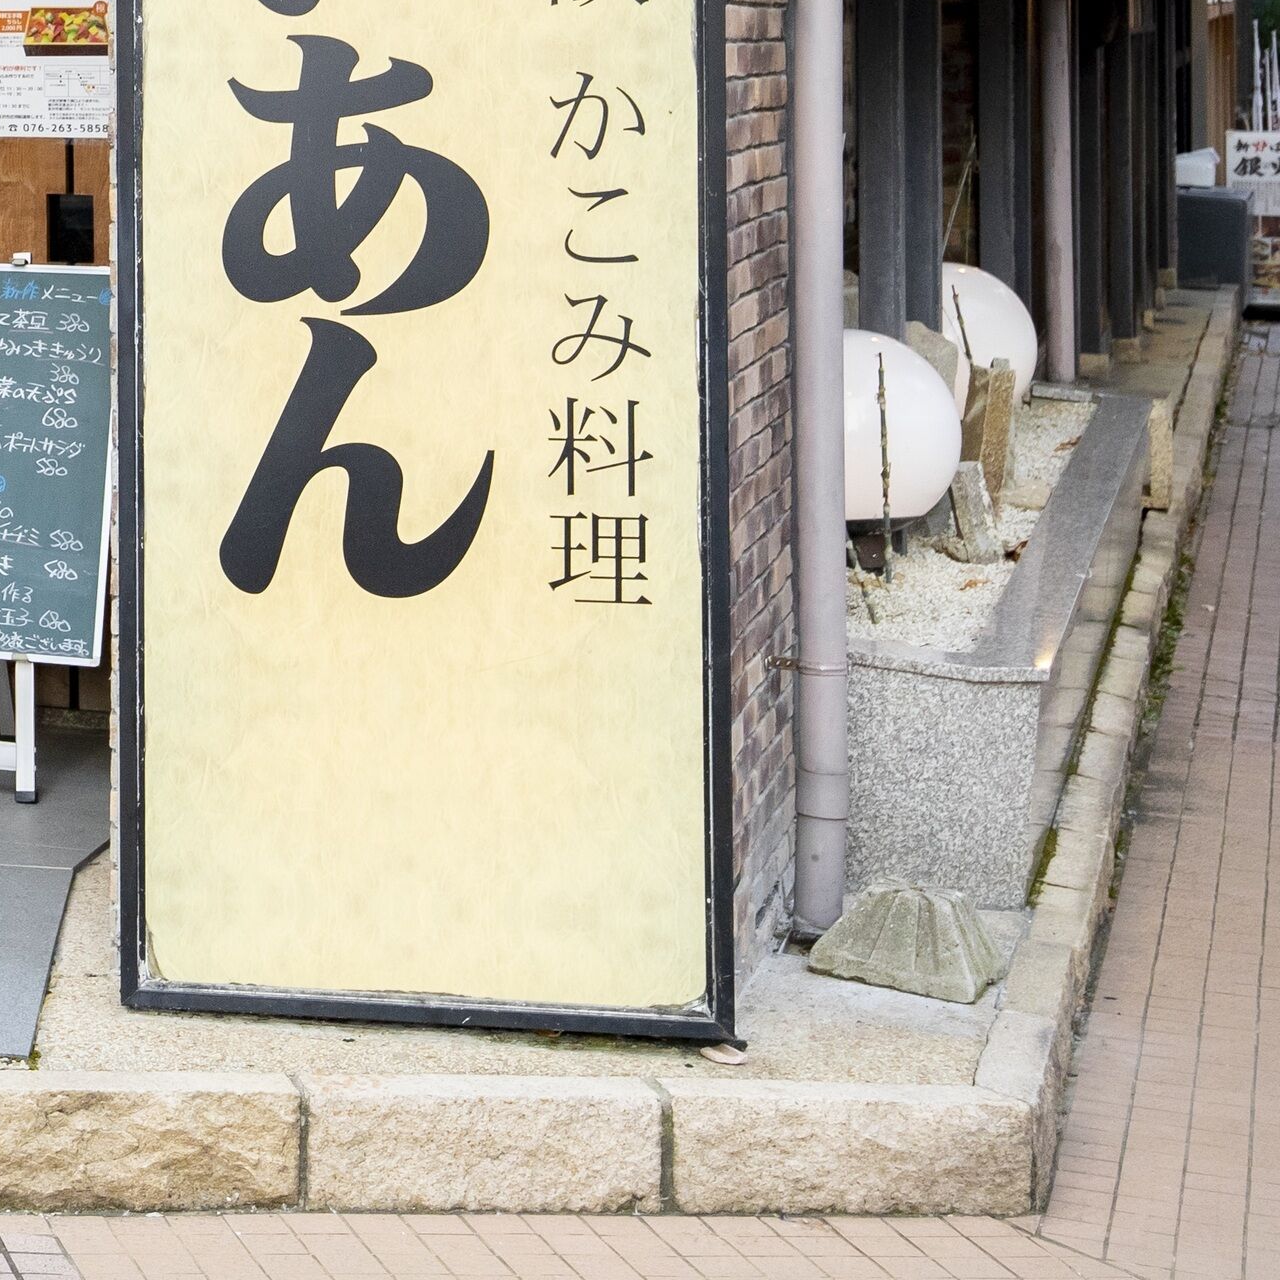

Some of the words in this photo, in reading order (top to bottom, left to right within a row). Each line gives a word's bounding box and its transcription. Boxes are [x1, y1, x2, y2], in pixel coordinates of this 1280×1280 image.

[23, 123, 109, 133] 076-263-5858
[56, 313, 90, 332] 380
[548, 69, 654, 608] かこみ料理
[50, 363, 80, 385] 380
[42, 407, 78, 429] 680
[36, 457, 68, 476] 580
[49, 530, 83, 551] 580
[39, 609, 72, 632] 680
